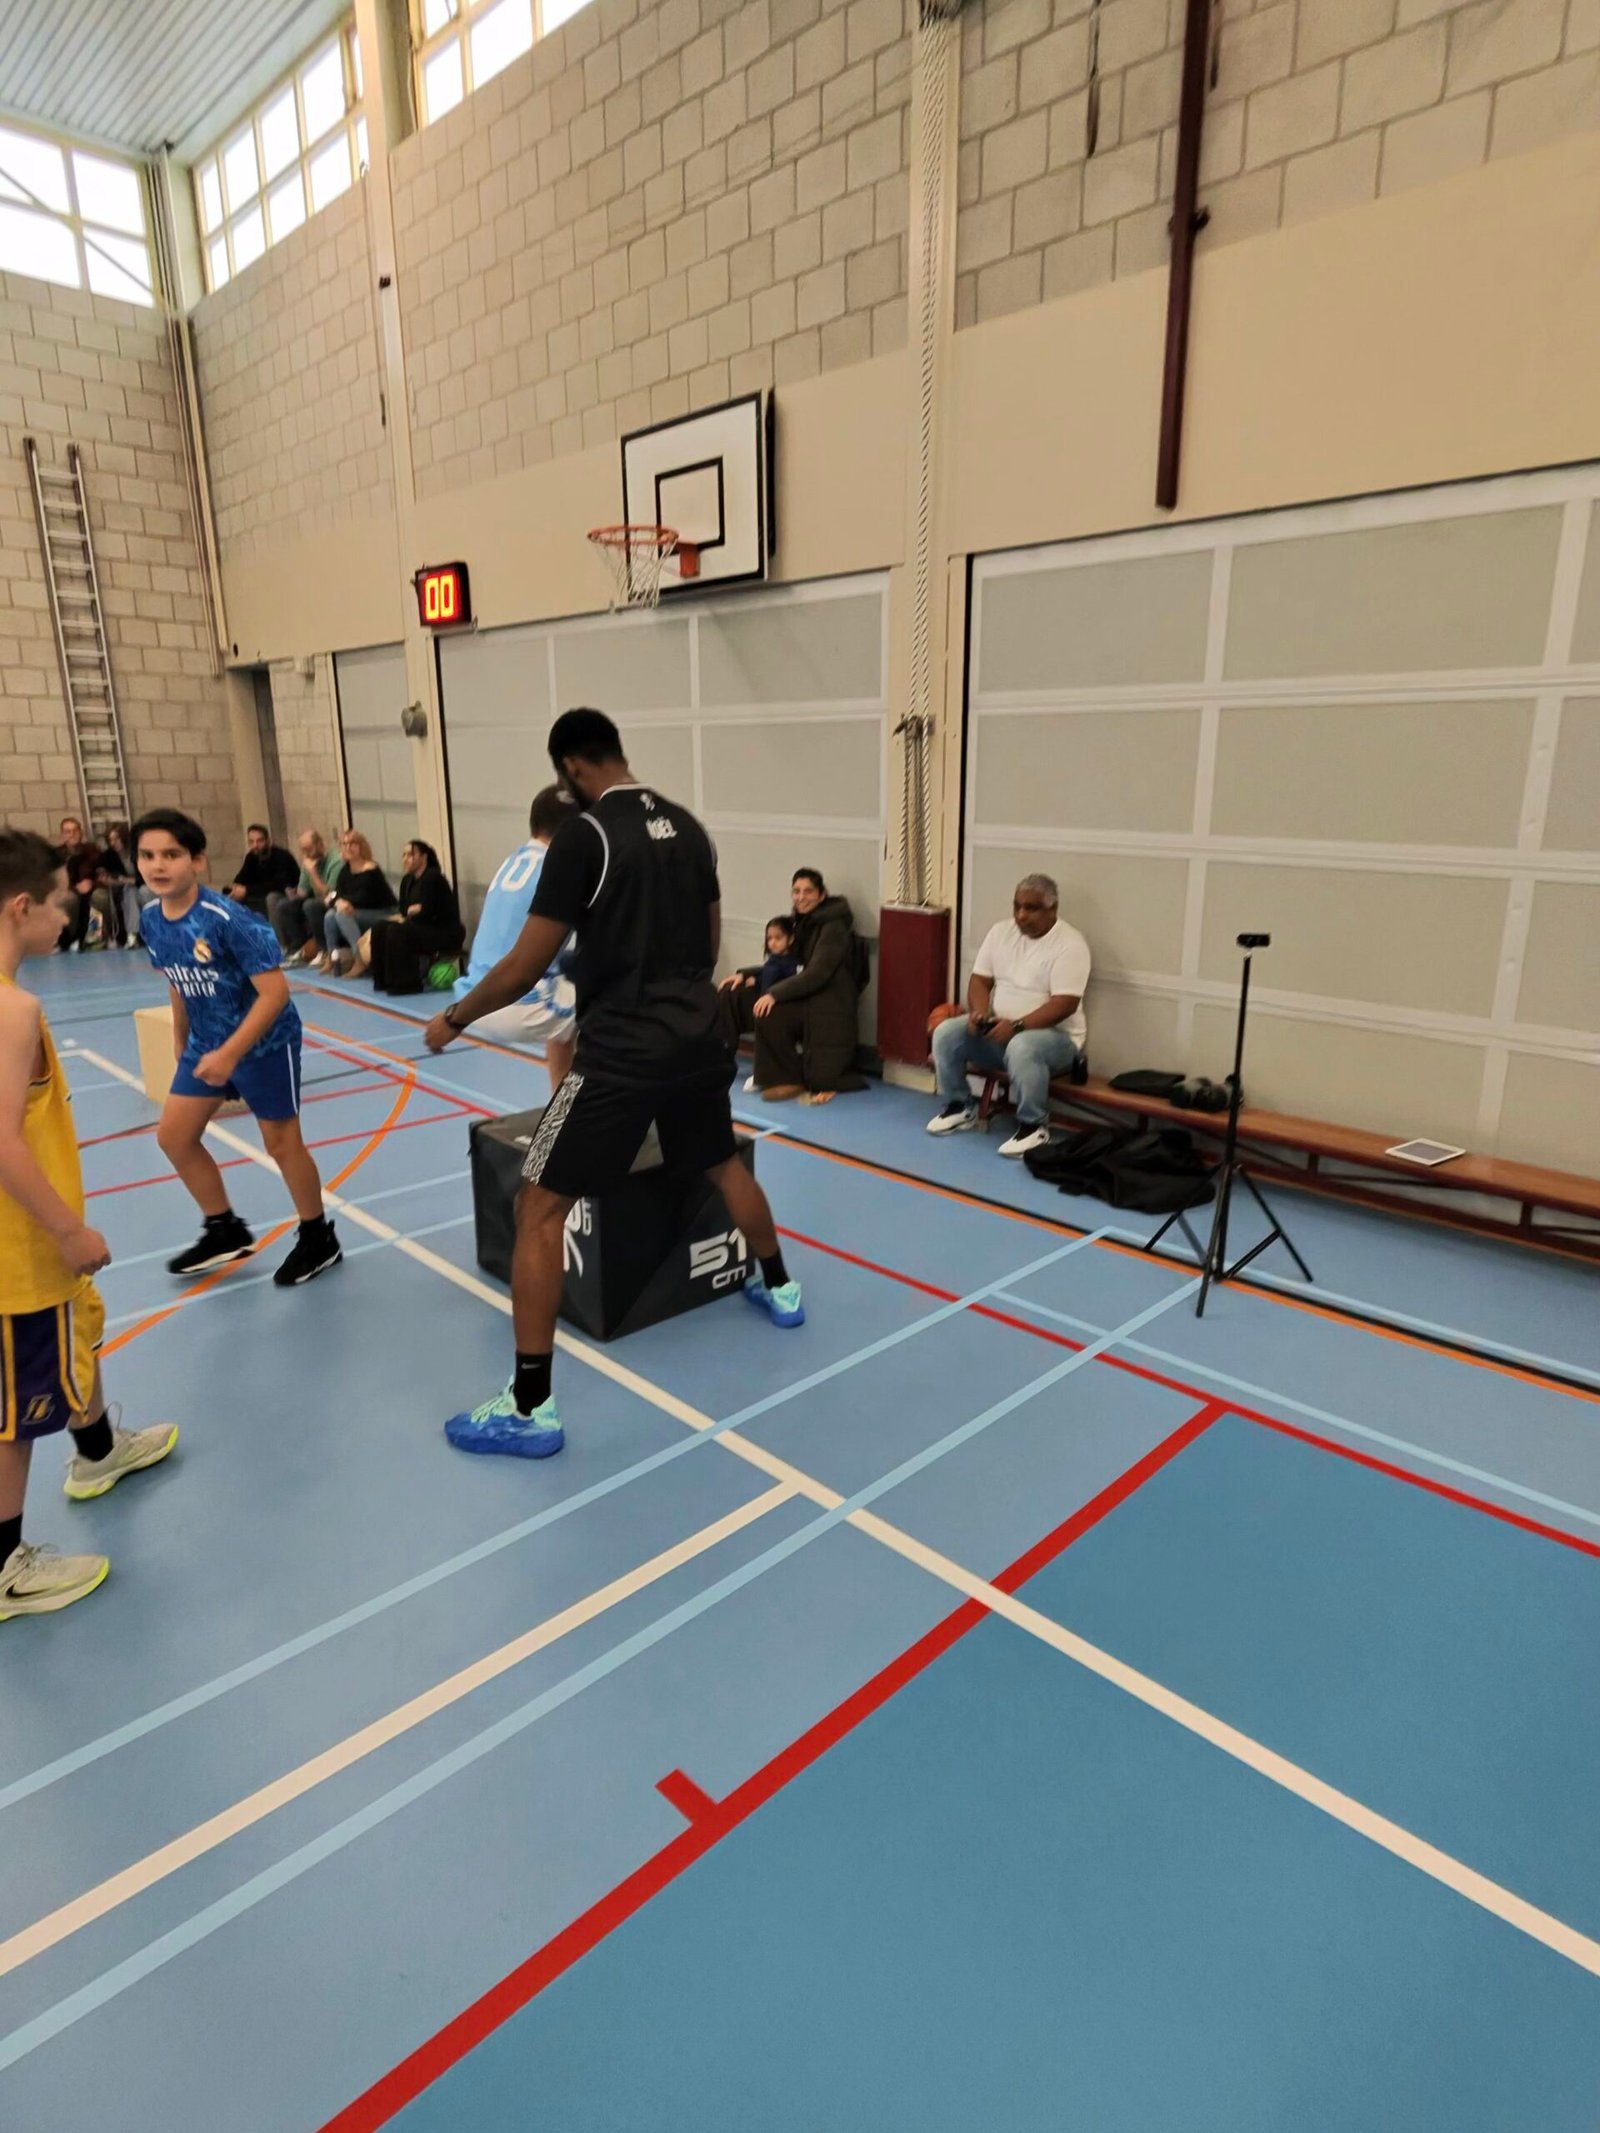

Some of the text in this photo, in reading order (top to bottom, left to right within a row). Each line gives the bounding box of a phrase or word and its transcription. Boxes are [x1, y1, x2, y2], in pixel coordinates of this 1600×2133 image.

[425, 574, 454, 620] 00
[689, 1227, 748, 1280] 51
[711, 1264, 747, 1290] cm
